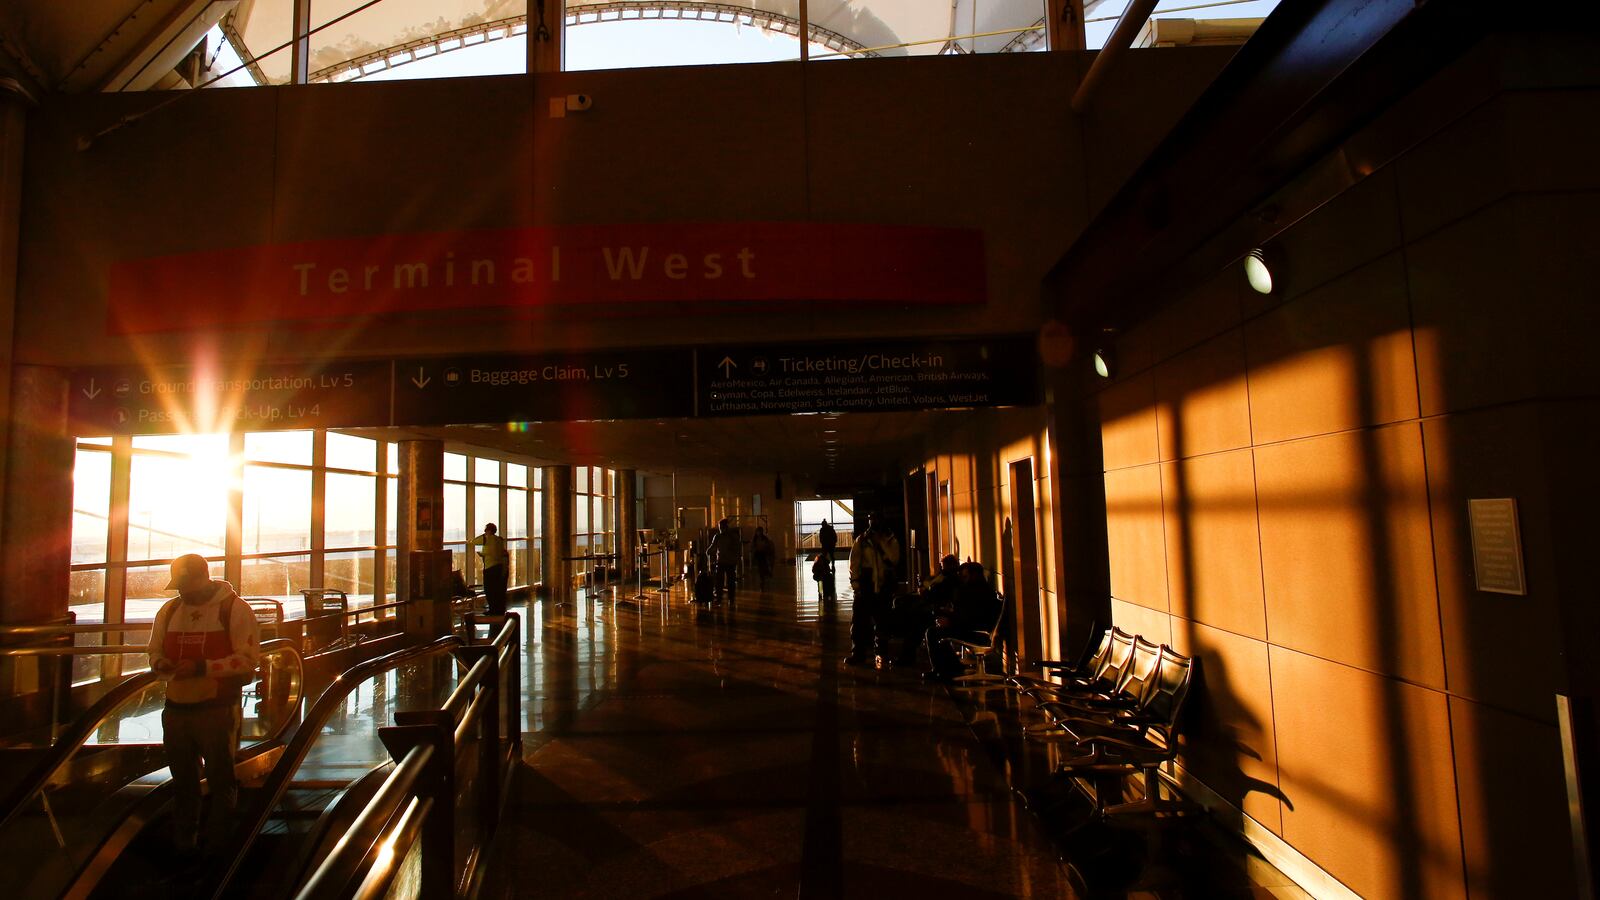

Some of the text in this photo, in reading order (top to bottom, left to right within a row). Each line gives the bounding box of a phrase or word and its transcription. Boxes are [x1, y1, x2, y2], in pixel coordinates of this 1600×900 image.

[293, 246, 757, 296] Terminal West
[780, 353, 943, 373] Ticketing/Check-in
[139, 373, 354, 394] Ground ransportation, Lv 5
[471, 363, 629, 386] Baggage Claim, Lv 5
[769, 378, 780, 388] Air
[917, 371, 948, 381] British
[222, 404, 283, 421] Pck-Up,
[288, 404, 306, 418] Lv
[310, 403, 321, 417] 4
[816, 398, 834, 408] Sun
